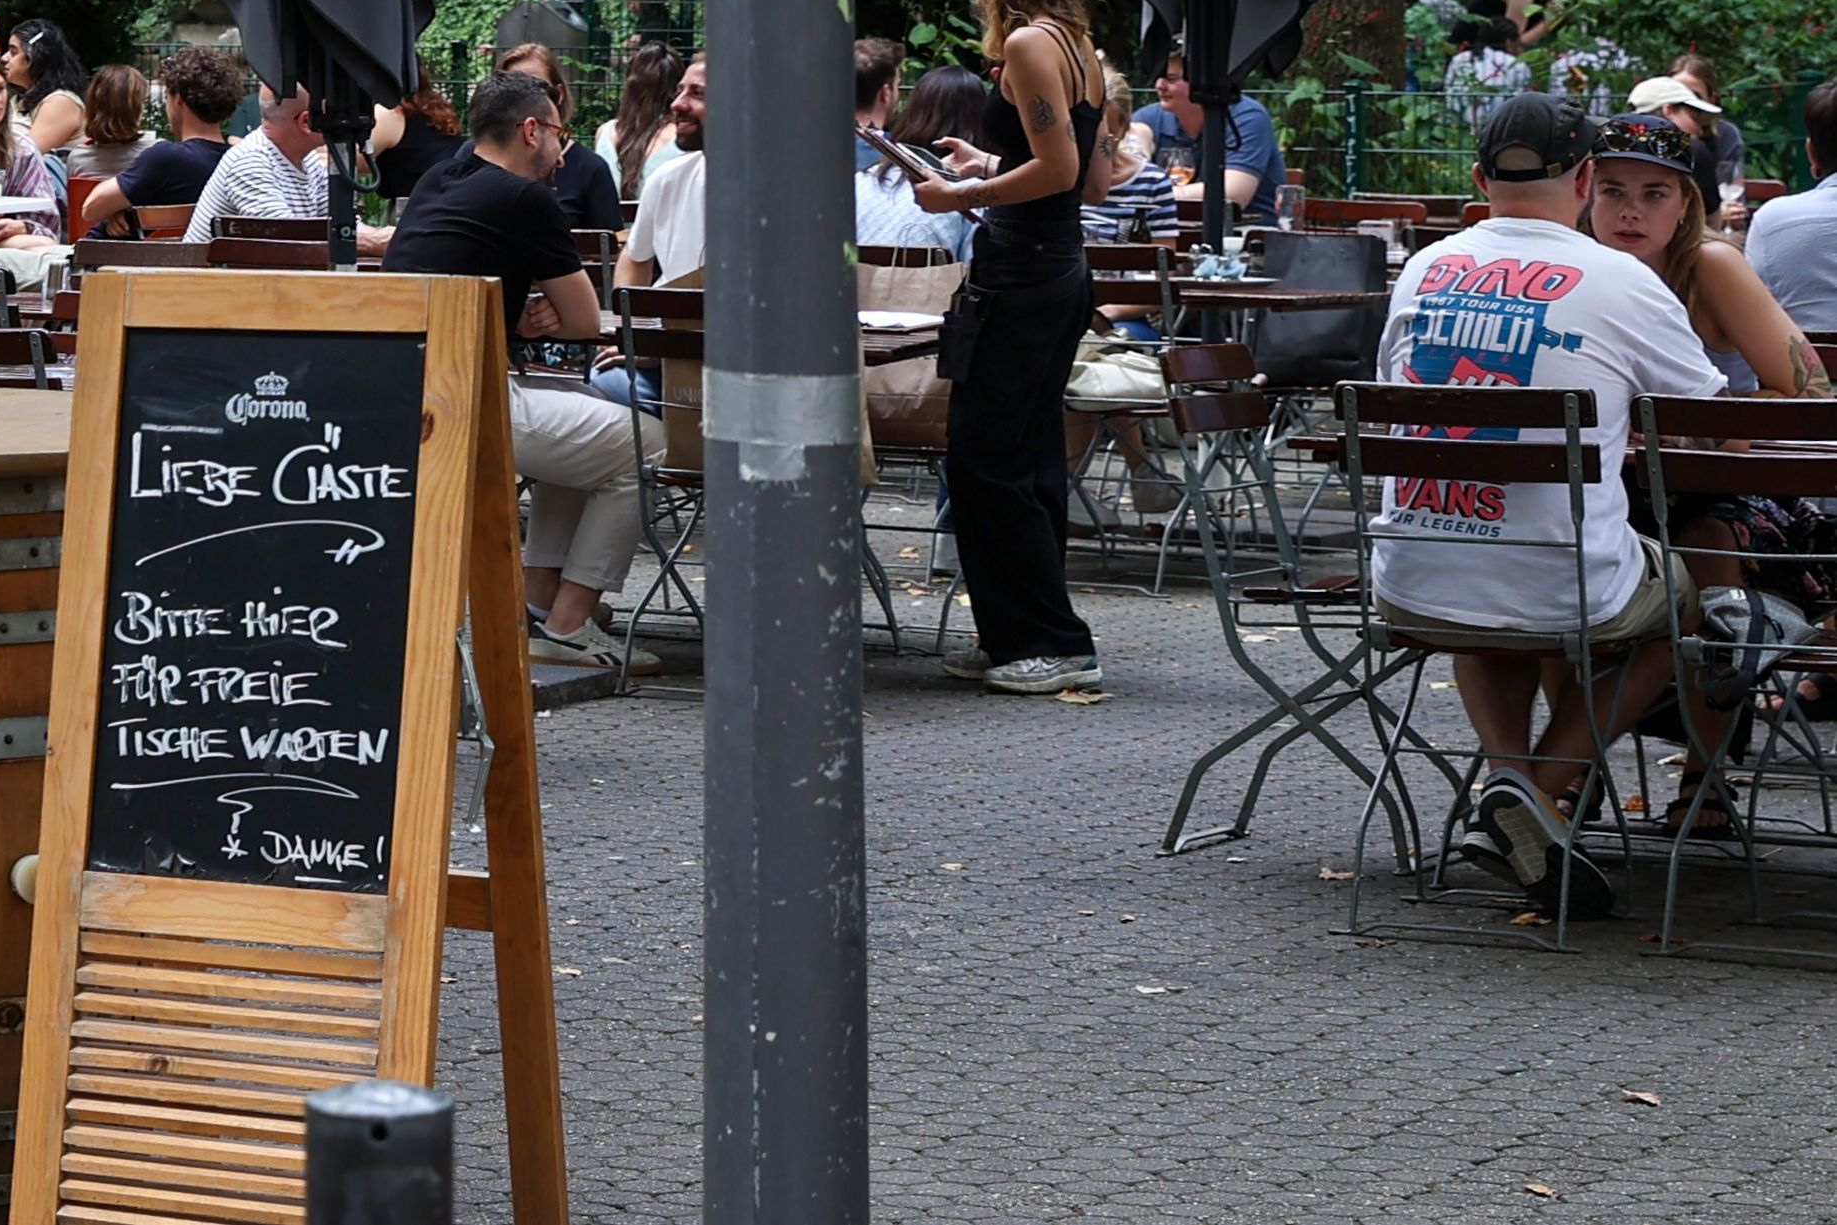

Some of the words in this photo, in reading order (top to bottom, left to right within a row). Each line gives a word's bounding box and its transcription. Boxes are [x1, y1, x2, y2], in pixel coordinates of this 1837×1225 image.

[1416, 253, 1584, 303] DYNO
[1459, 297, 1500, 311] TOUR
[1504, 303, 1536, 316] USA
[225, 392, 310, 425] Corona
[272, 422, 412, 505] GÄSTE
[1394, 476, 1507, 521] VANS
[1420, 516, 1502, 537] LEGENDS
[112, 654, 188, 707] FÜR
[239, 726, 390, 765] WARTEN
